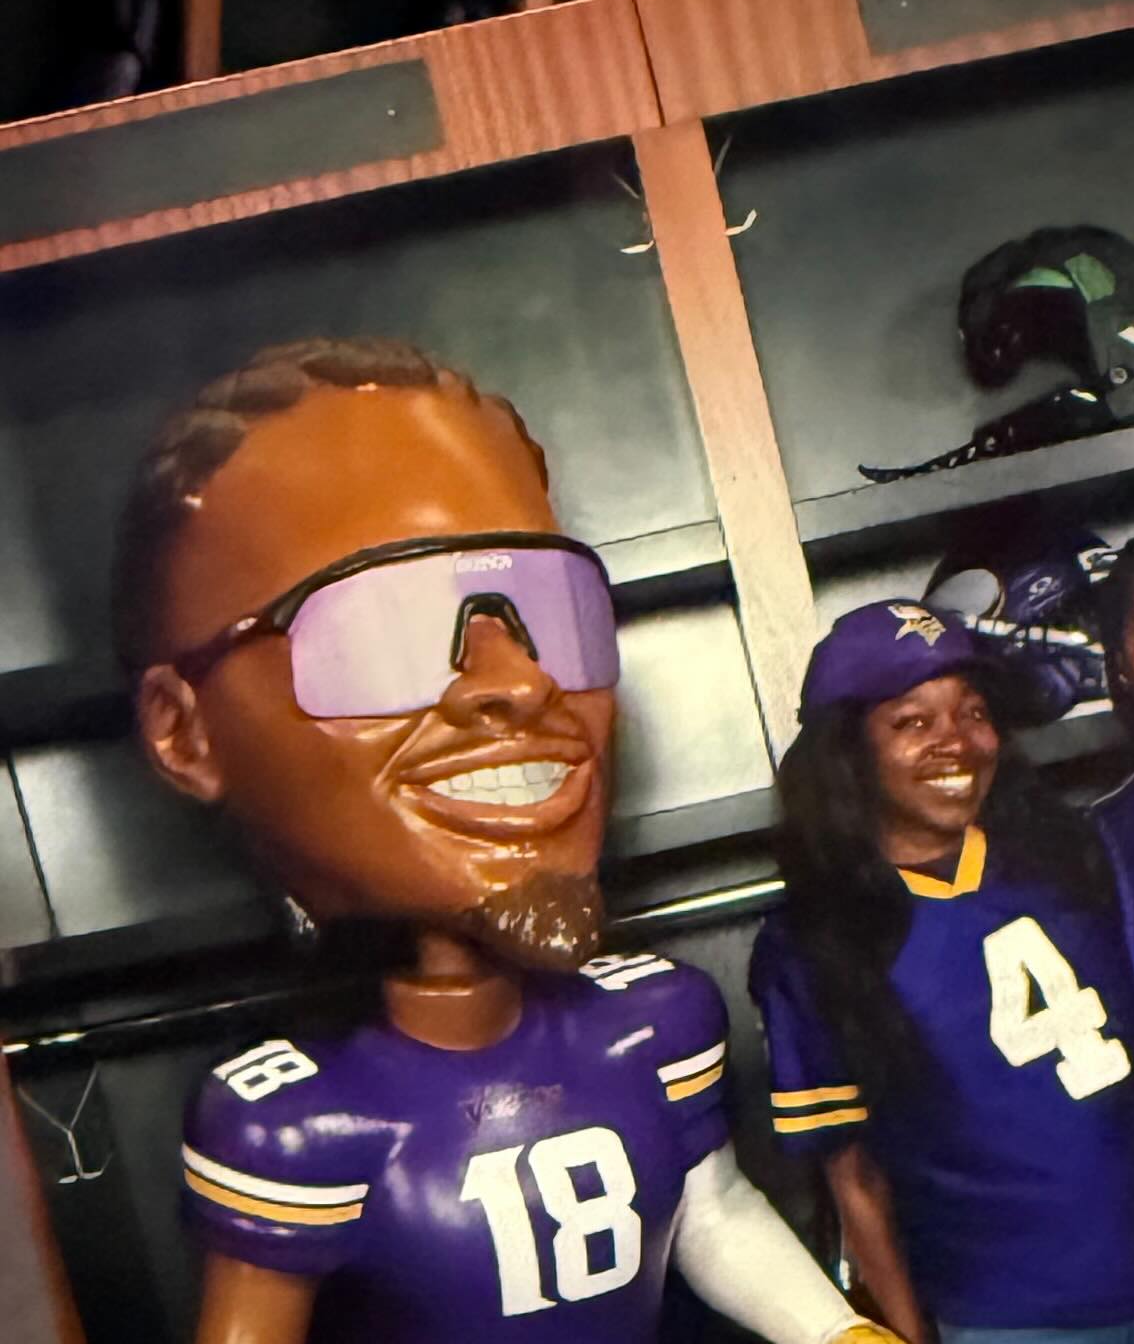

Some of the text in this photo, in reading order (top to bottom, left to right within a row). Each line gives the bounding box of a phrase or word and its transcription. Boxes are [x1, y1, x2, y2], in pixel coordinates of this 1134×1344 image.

[212, 1039, 319, 1102] 18
[983, 916, 1132, 1100] 4
[459, 1127, 642, 1317] 18
